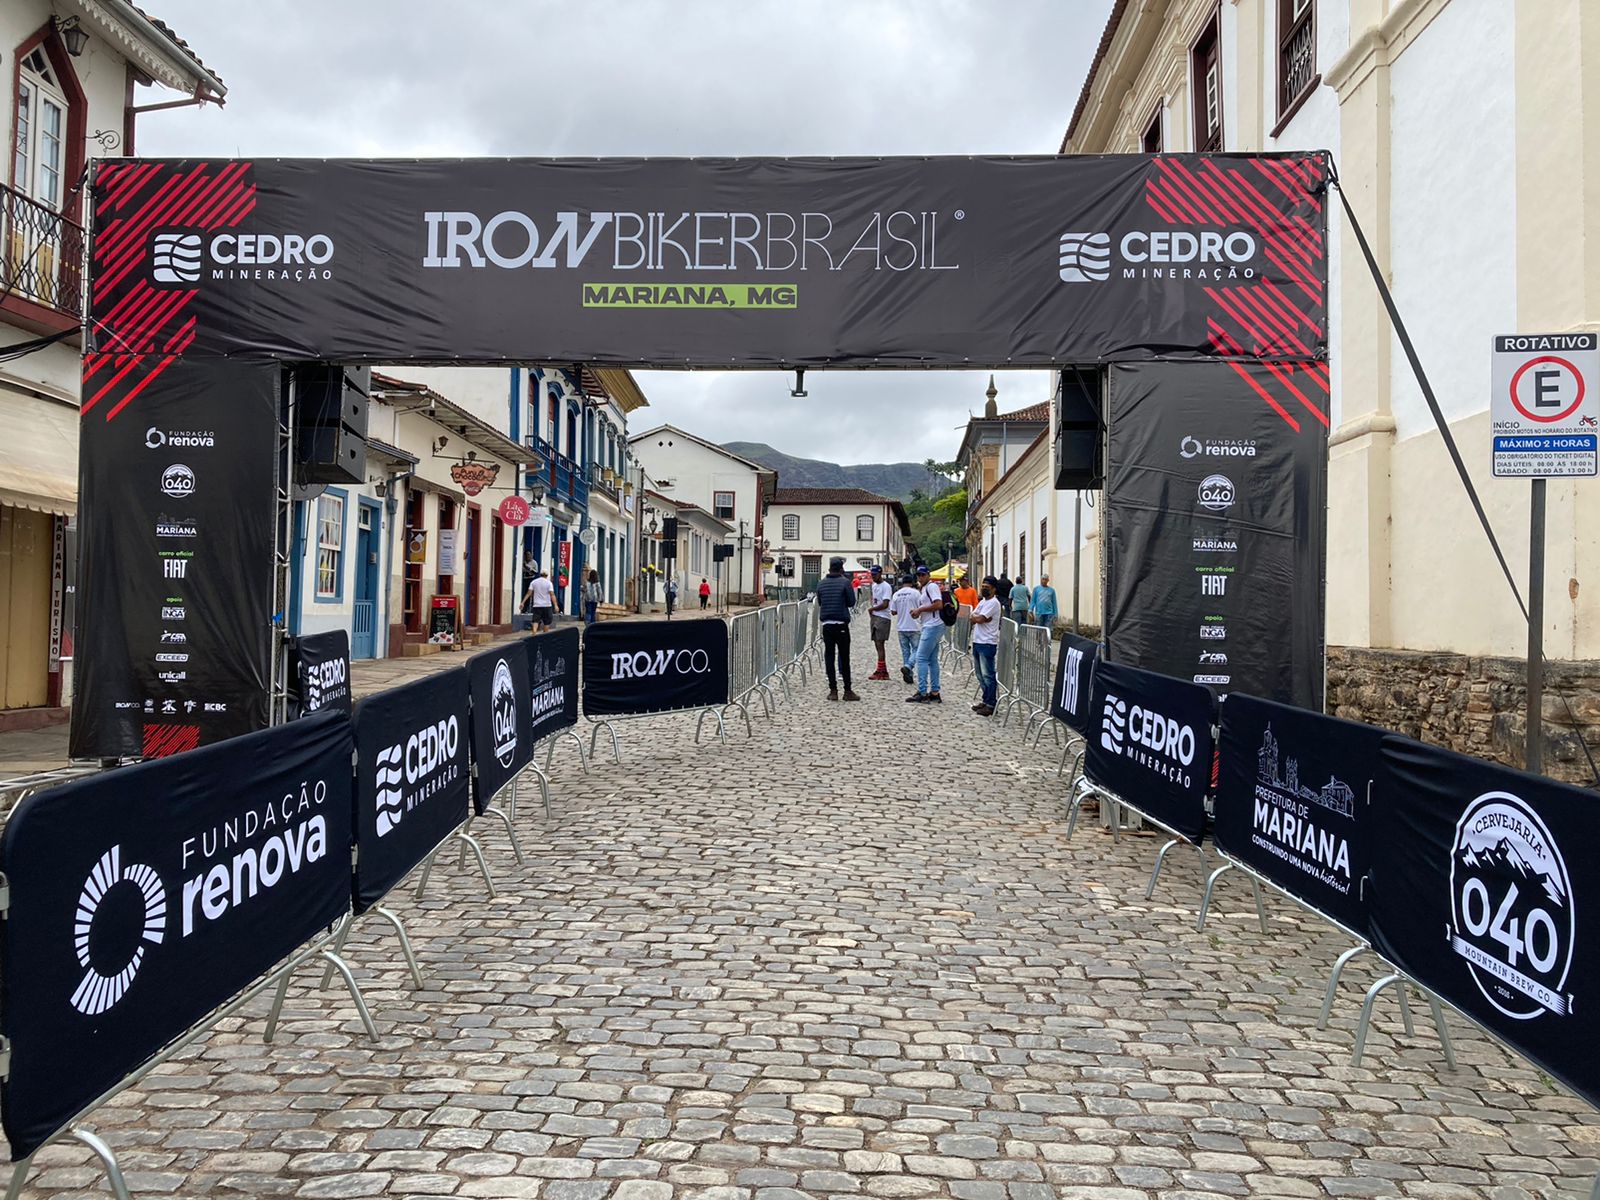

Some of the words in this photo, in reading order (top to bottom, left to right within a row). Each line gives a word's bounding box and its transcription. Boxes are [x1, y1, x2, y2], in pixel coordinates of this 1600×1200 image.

[210, 233, 334, 264] CEDRO
[1120, 231, 1256, 263] CEDRO
[212, 267, 332, 281] MINERAÇÃO
[1123, 266, 1254, 280] MINERAÇÃO
[585, 286, 736, 307] MARIANA,
[746, 286, 797, 305] MG
[1504, 336, 1590, 350] ROTATIVO
[1535, 370, 1561, 408] E
[1493, 421, 1520, 429] INÍCIO
[169, 436, 214, 447] renova
[1206, 446, 1256, 456] renova
[1499, 438, 1541, 448] MÁXIMO
[1543, 440, 1550, 448] 2
[1553, 439, 1590, 448] HORAS
[165, 477, 191, 490] 040
[1202, 488, 1231, 502] 040
[54, 515, 63, 579] MARIANA
[1193, 541, 1238, 549] MARIANA
[164, 559, 188, 578] FIAT
[1202, 575, 1227, 595] FIAT
[52, 591, 60, 655] TURISMO
[158, 671, 186, 679] unicall
[320, 657, 345, 689] CEDRO
[532, 686, 564, 718] MARIANA
[495, 701, 515, 742] 040
[1129, 705, 1195, 766] CEDRO
[405, 714, 458, 784] CEDRO
[1126, 746, 1190, 788] MINERAÇÃO
[407, 764, 457, 812] MINERAÇÃO
[1255, 784, 1297, 812] PREFEITURA
[1298, 803, 1309, 819] DE
[182, 780, 326, 869] FUNDAÇÃO
[1253, 798, 1350, 879] MARIANA
[1475, 813, 1543, 857] CERVEJARIA
[1252, 833, 1288, 861] CONSTRUINDO
[1289, 852, 1302, 869] UMA
[1302, 860, 1320, 879] NOVA
[182, 814, 326, 938] renova
[1462, 877, 1558, 973] 040
[1465, 945, 1508, 977] MOUNTAIN
[1510, 971, 1534, 993] BREW
[1537, 988, 1553, 1006] CO.
